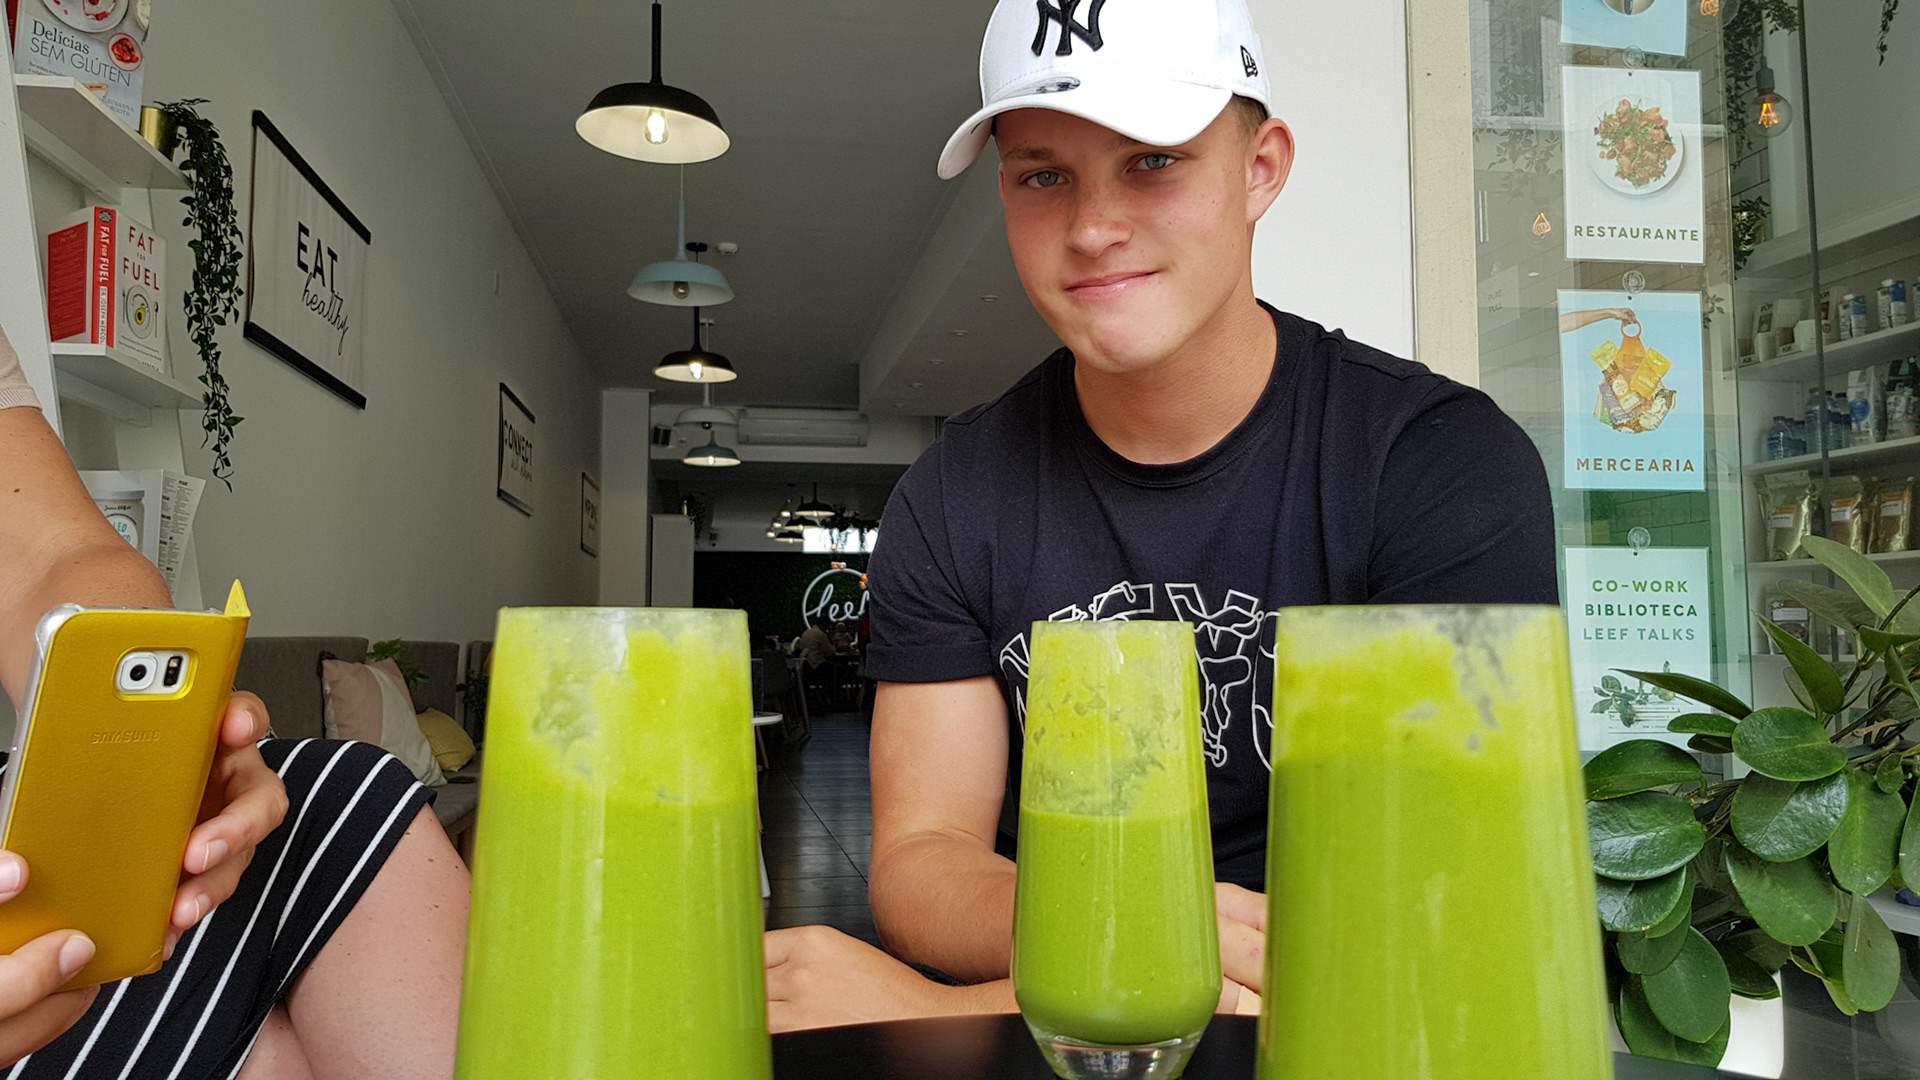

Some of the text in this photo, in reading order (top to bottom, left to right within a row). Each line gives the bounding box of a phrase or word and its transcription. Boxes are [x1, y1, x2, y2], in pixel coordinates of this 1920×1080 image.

[30, 37, 131, 87] SEM GLÚTEN
[100, 225, 110, 244] FAT
[129, 226, 155, 254] FAT
[1574, 225, 1699, 241] RESTAURANTE
[297, 221, 338, 293] EAT
[99, 256, 109, 283] FUEL
[123, 257, 160, 291] FUEL
[302, 272, 349, 356] healthy
[504, 419, 533, 466] CONNECT
[1577, 457, 1695, 472] MERCEARIA
[1592, 580, 1688, 593] CO-WORK
[1585, 604, 1698, 617] BIBLIOTECA
[1583, 628, 1695, 641] LEEF TALKS
[91, 730, 161, 745] SAMSUNG
